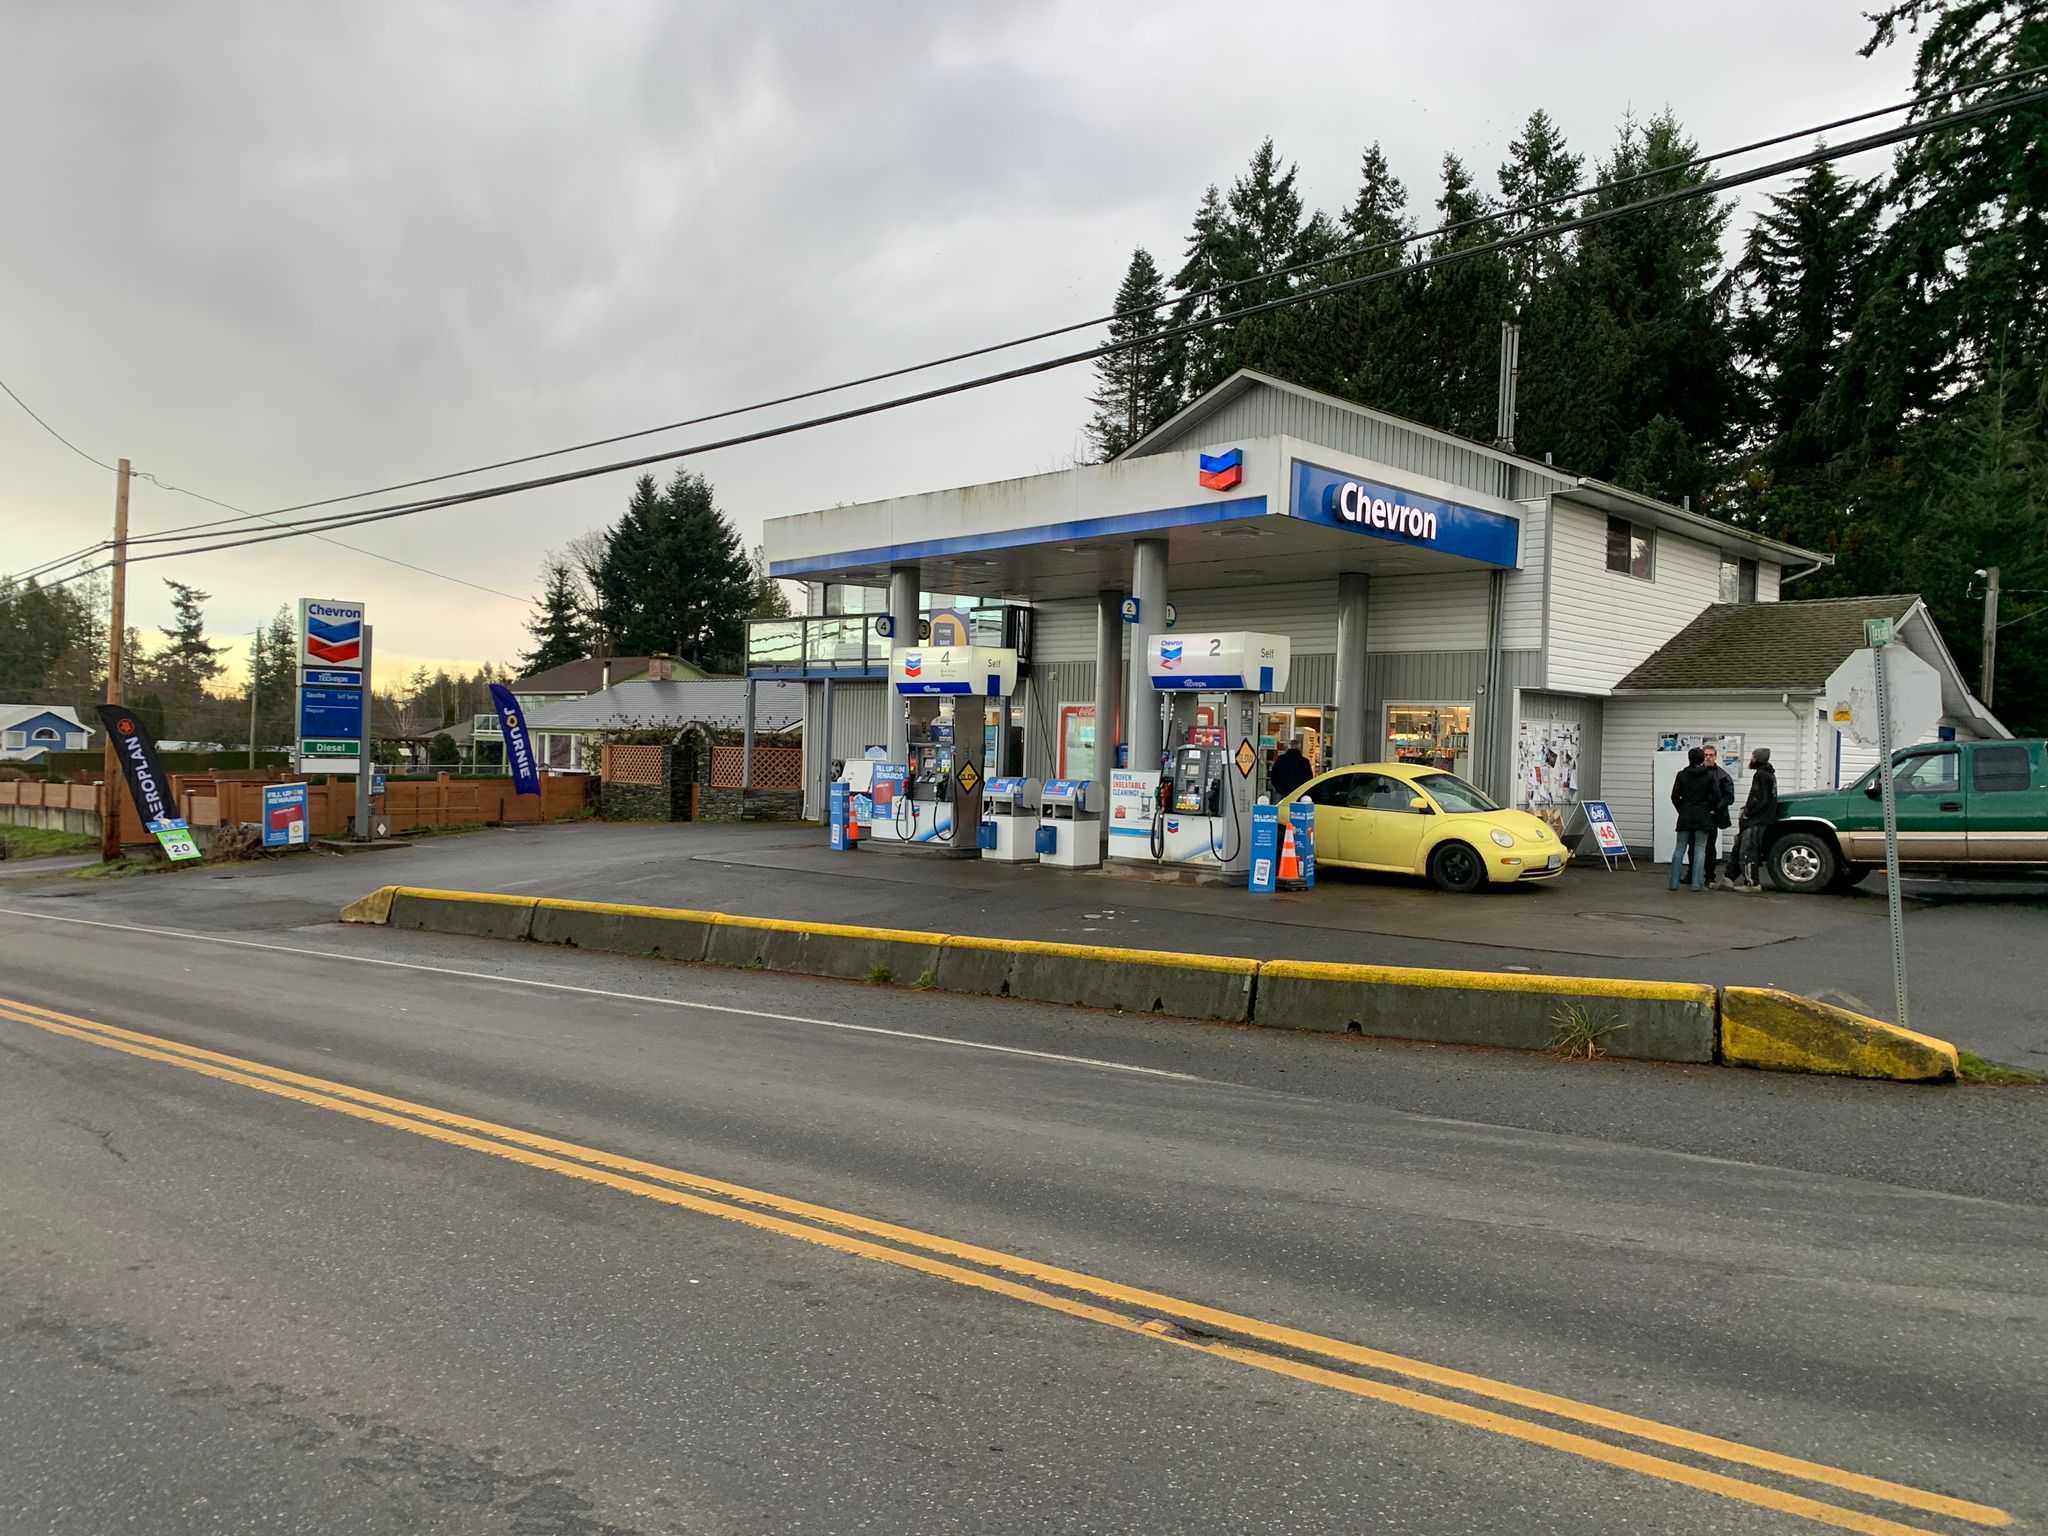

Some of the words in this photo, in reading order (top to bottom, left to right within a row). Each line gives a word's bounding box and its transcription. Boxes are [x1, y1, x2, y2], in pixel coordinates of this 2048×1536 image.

[1340, 481, 1437, 540] Chevron
[308, 603, 361, 618] Chevron
[1126, 602, 1133, 613] 2
[1209, 638, 1221, 656] 2
[1260, 647, 1274, 659] Self
[941, 650, 951, 666] 4
[987, 658, 1001, 668] Self
[316, 743, 345, 752] Diesel
[503, 706, 532, 779] JOURNIE
[124, 735, 166, 822] AEROPLAN
[1599, 825, 1616, 839] 46
[171, 843, 190, 853] 20
